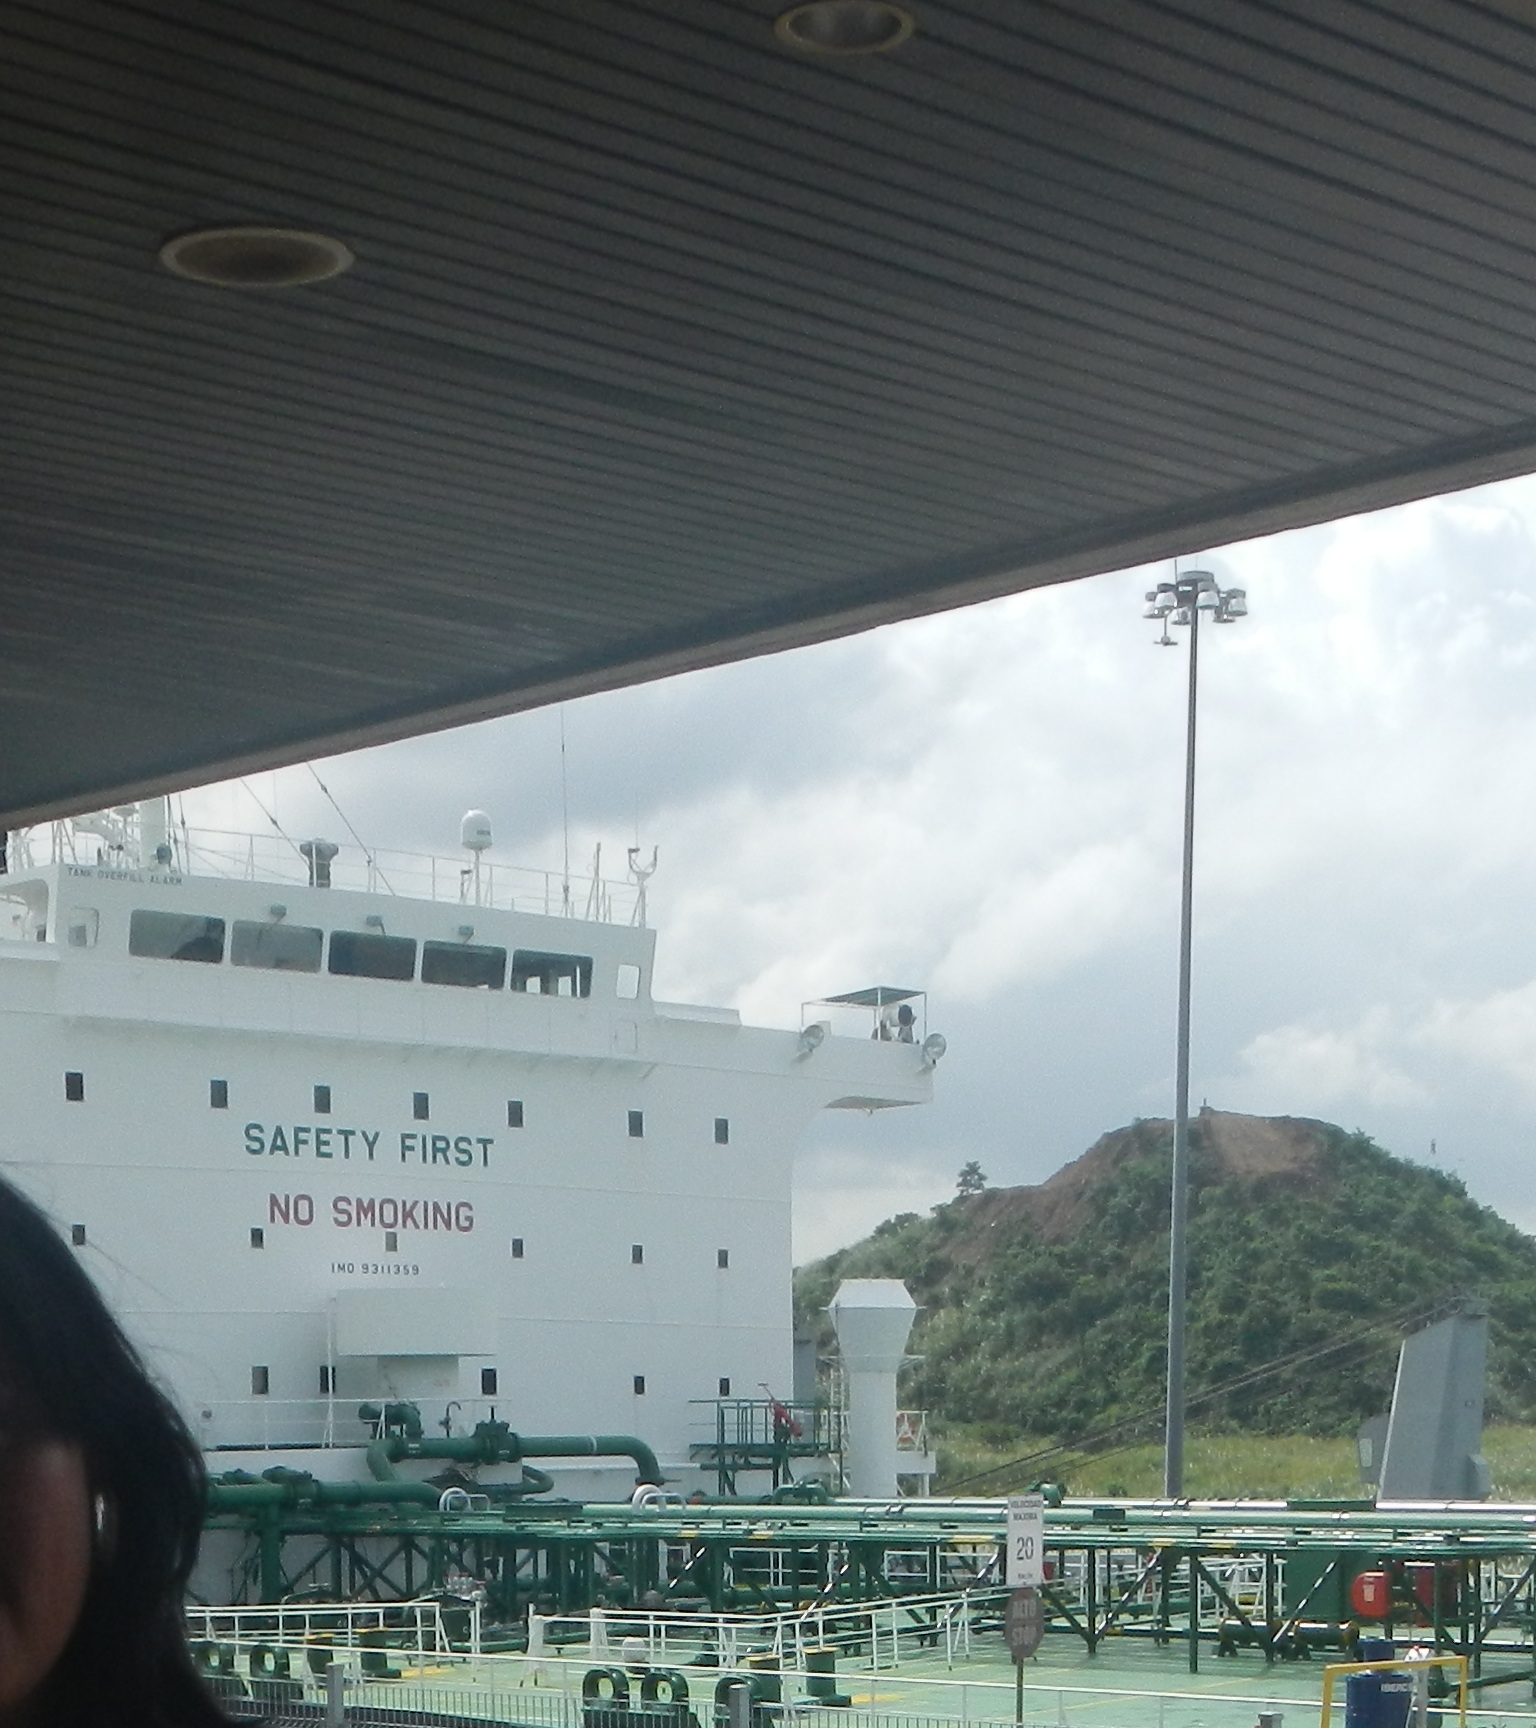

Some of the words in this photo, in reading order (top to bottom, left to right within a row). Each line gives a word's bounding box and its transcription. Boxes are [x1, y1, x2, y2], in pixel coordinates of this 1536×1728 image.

[68, 866, 91, 878] TANK
[97, 870, 144, 883] OVERFILL
[149, 876, 183, 886] ALARM
[243, 1122, 381, 1161] SAFETY
[399, 1132, 495, 1168] FIRST
[268, 1192, 314, 1227] NO
[332, 1196, 475, 1233] SMOKING
[331, 1262, 355, 1274] IMO
[361, 1263, 420, 1276] 9311359
[1016, 1536, 1034, 1560] 20
